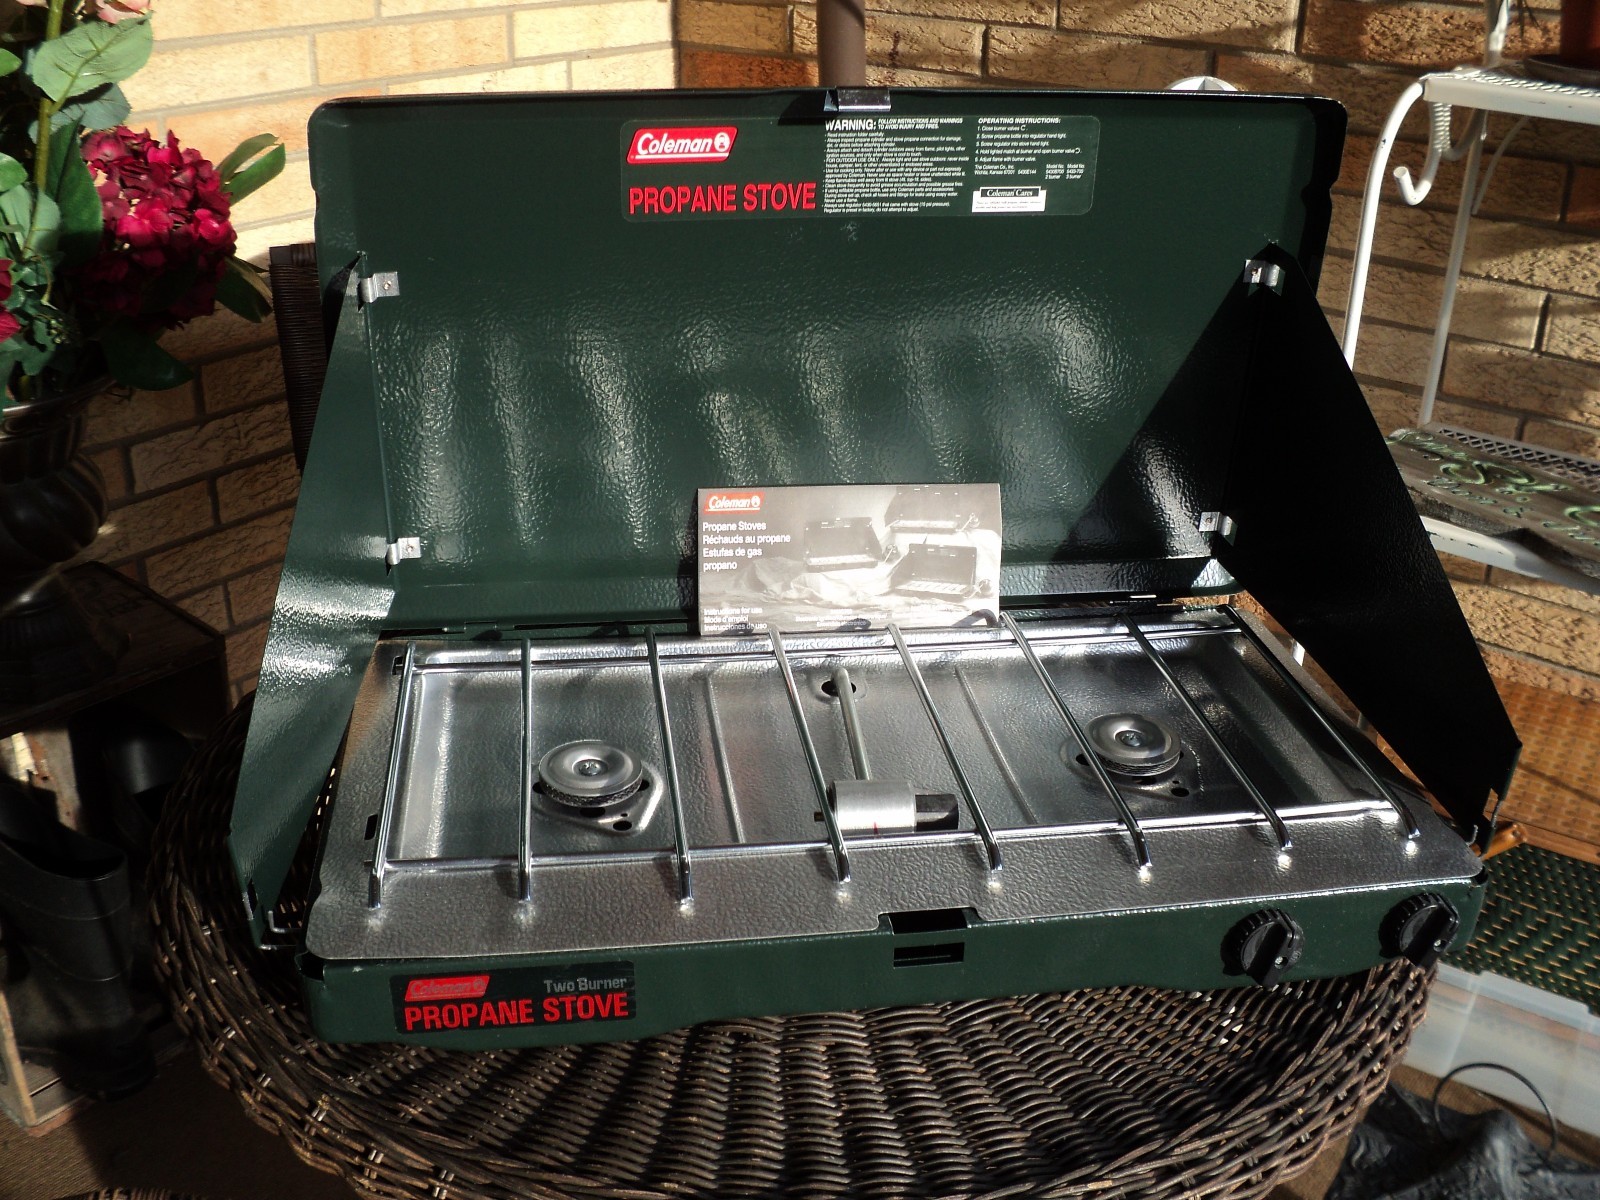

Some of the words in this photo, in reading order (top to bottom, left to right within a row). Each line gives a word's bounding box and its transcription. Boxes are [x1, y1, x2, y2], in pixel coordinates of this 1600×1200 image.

[825, 119, 876, 130] WARNING:
[637, 132, 713, 155] Coleman
[629, 184, 737, 214] PROPANE
[744, 182, 816, 210] STOVE
[708, 496, 750, 509] Coleman
[703, 522, 737, 532] Propane
[738, 521, 766, 530] Stoves
[703, 534, 743, 545] Réchauds
[757, 535, 791, 545] propane
[703, 548, 734, 557] Estufas
[735, 547, 745, 556] de
[747, 548, 762, 558] gas
[703, 562, 737, 572] propano
[410, 980, 472, 997] Coleman
[544, 979, 575, 994] Two
[577, 976, 627, 992] Burner
[404, 1000, 535, 1030] PROPANE
[542, 993, 628, 1022] STOVE
